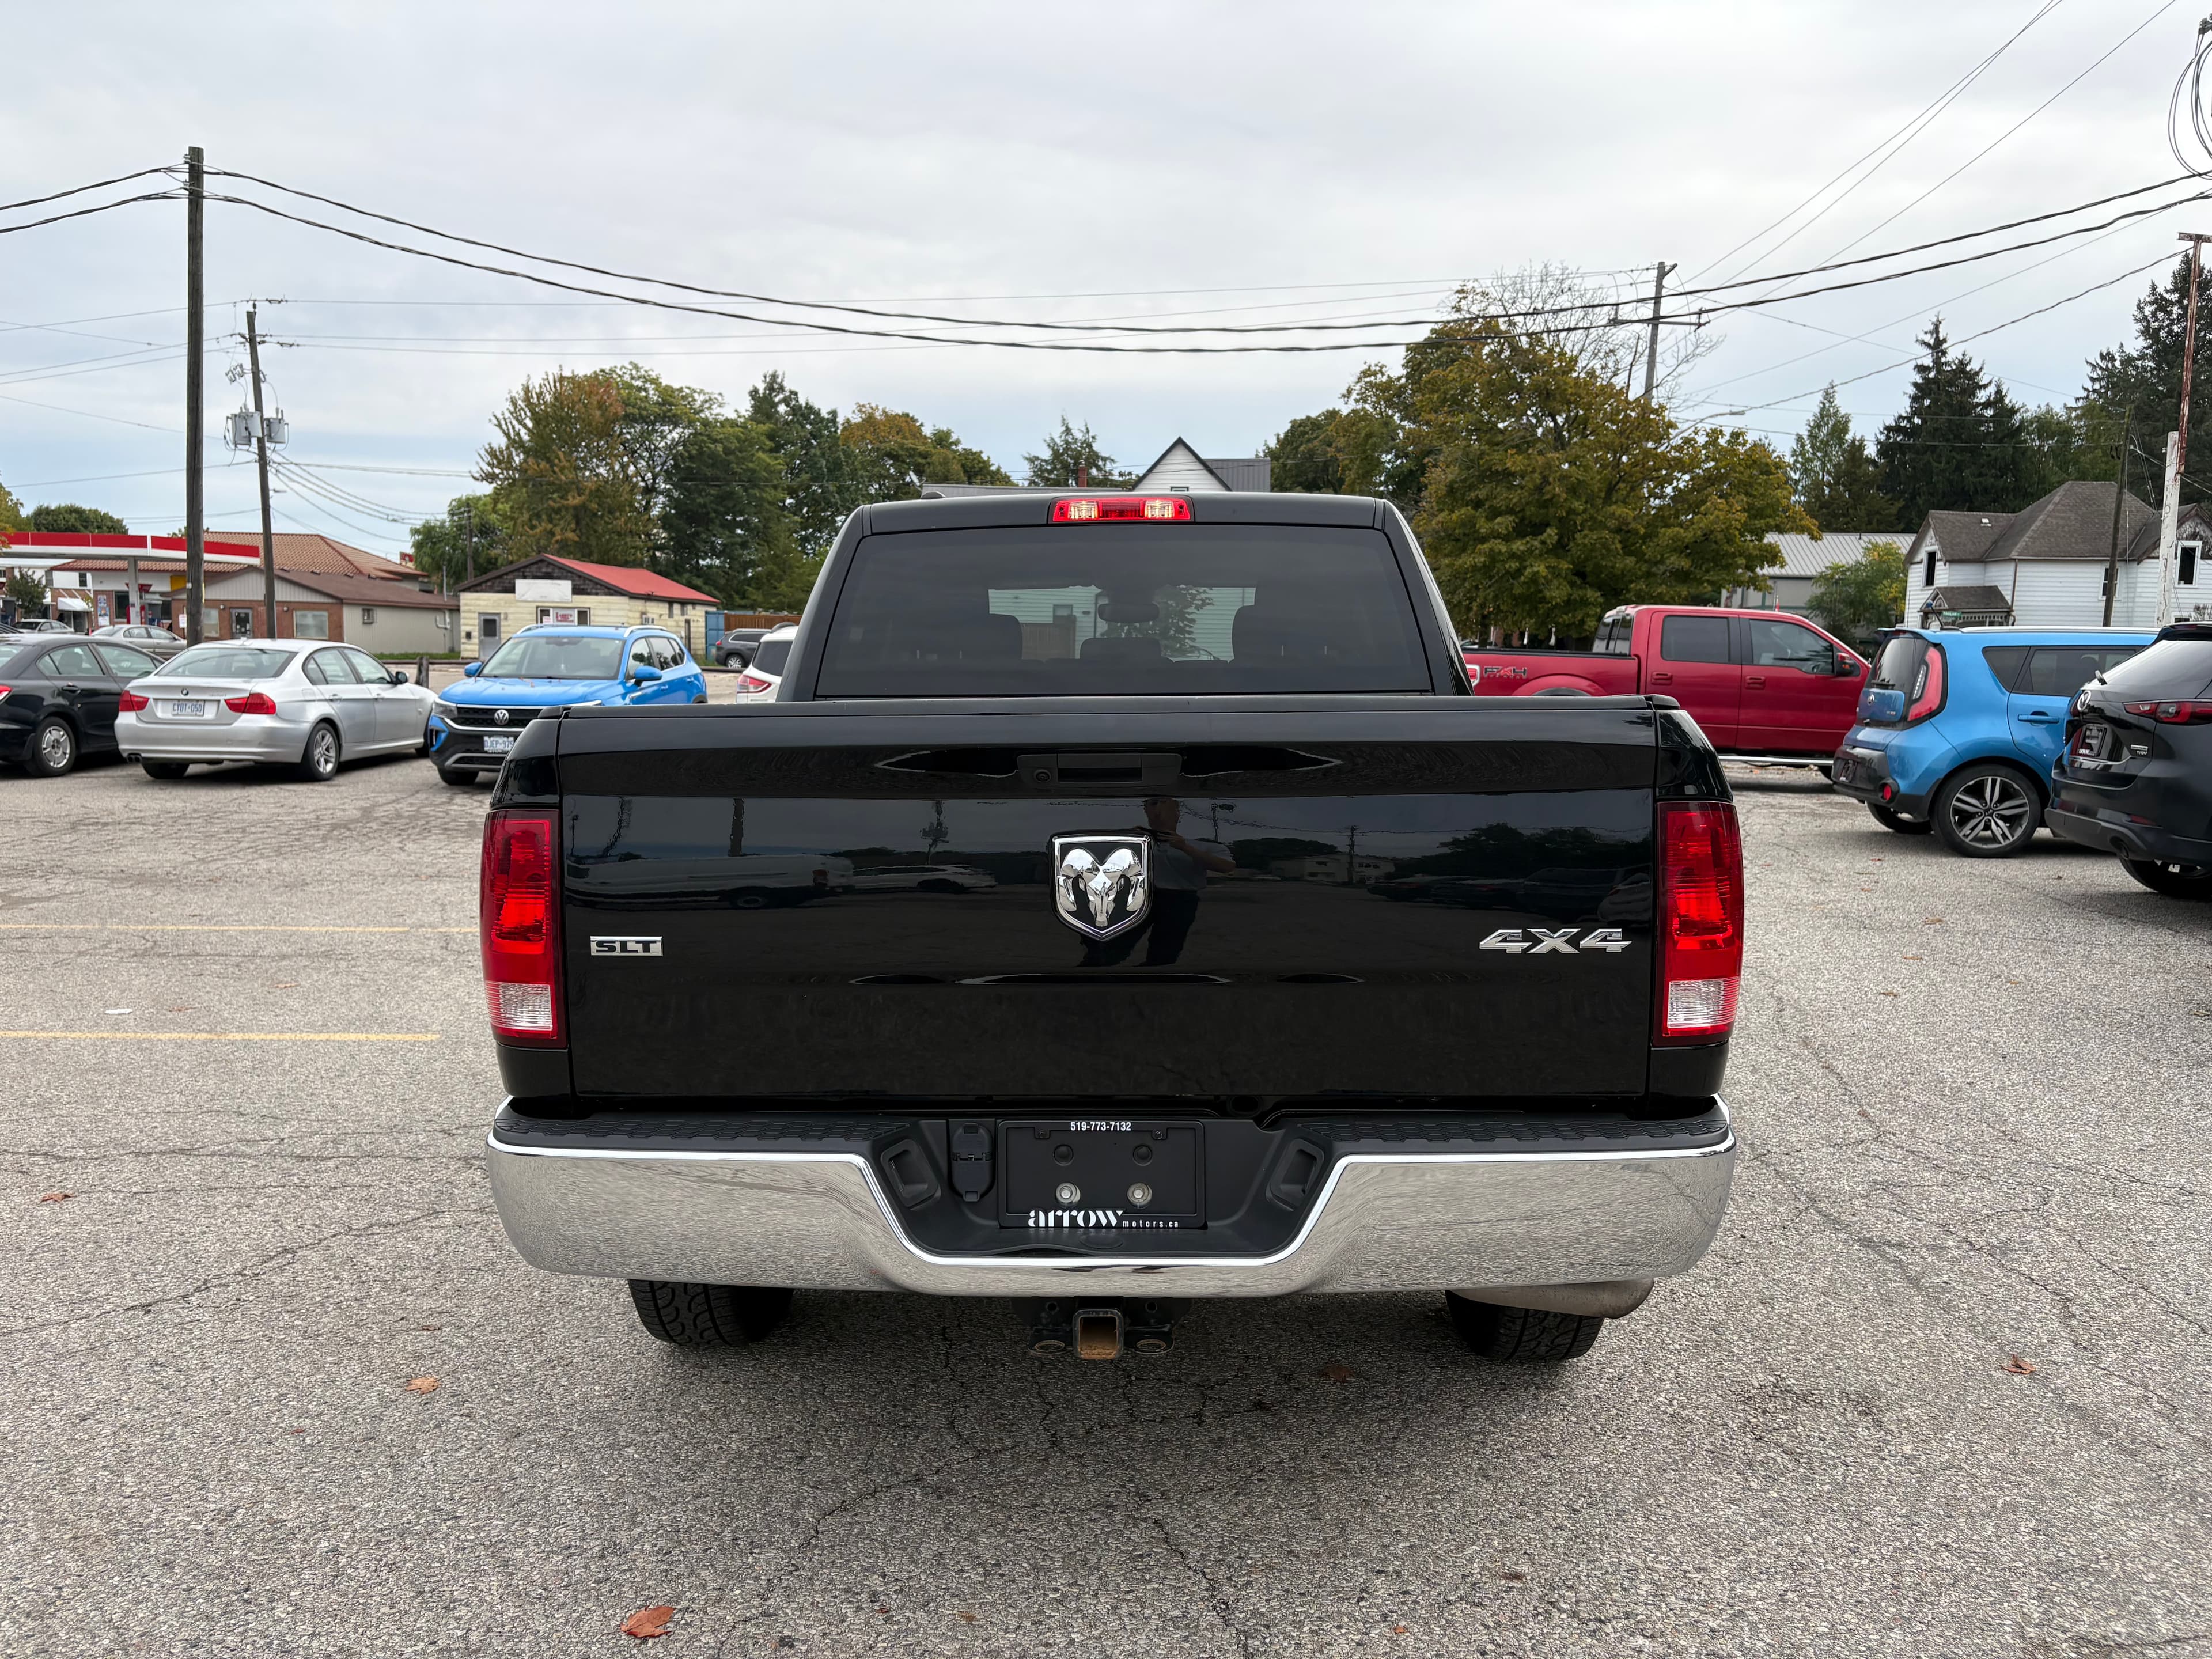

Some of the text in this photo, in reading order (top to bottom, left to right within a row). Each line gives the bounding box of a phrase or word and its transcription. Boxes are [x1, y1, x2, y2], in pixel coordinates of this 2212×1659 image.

[595, 940, 657, 953] SLT
[1479, 928, 1633, 953] 4X4
[1070, 1122, 1131, 1131] 519-773-7132
[1028, 1210, 1179, 1228] arrow motors.ca
